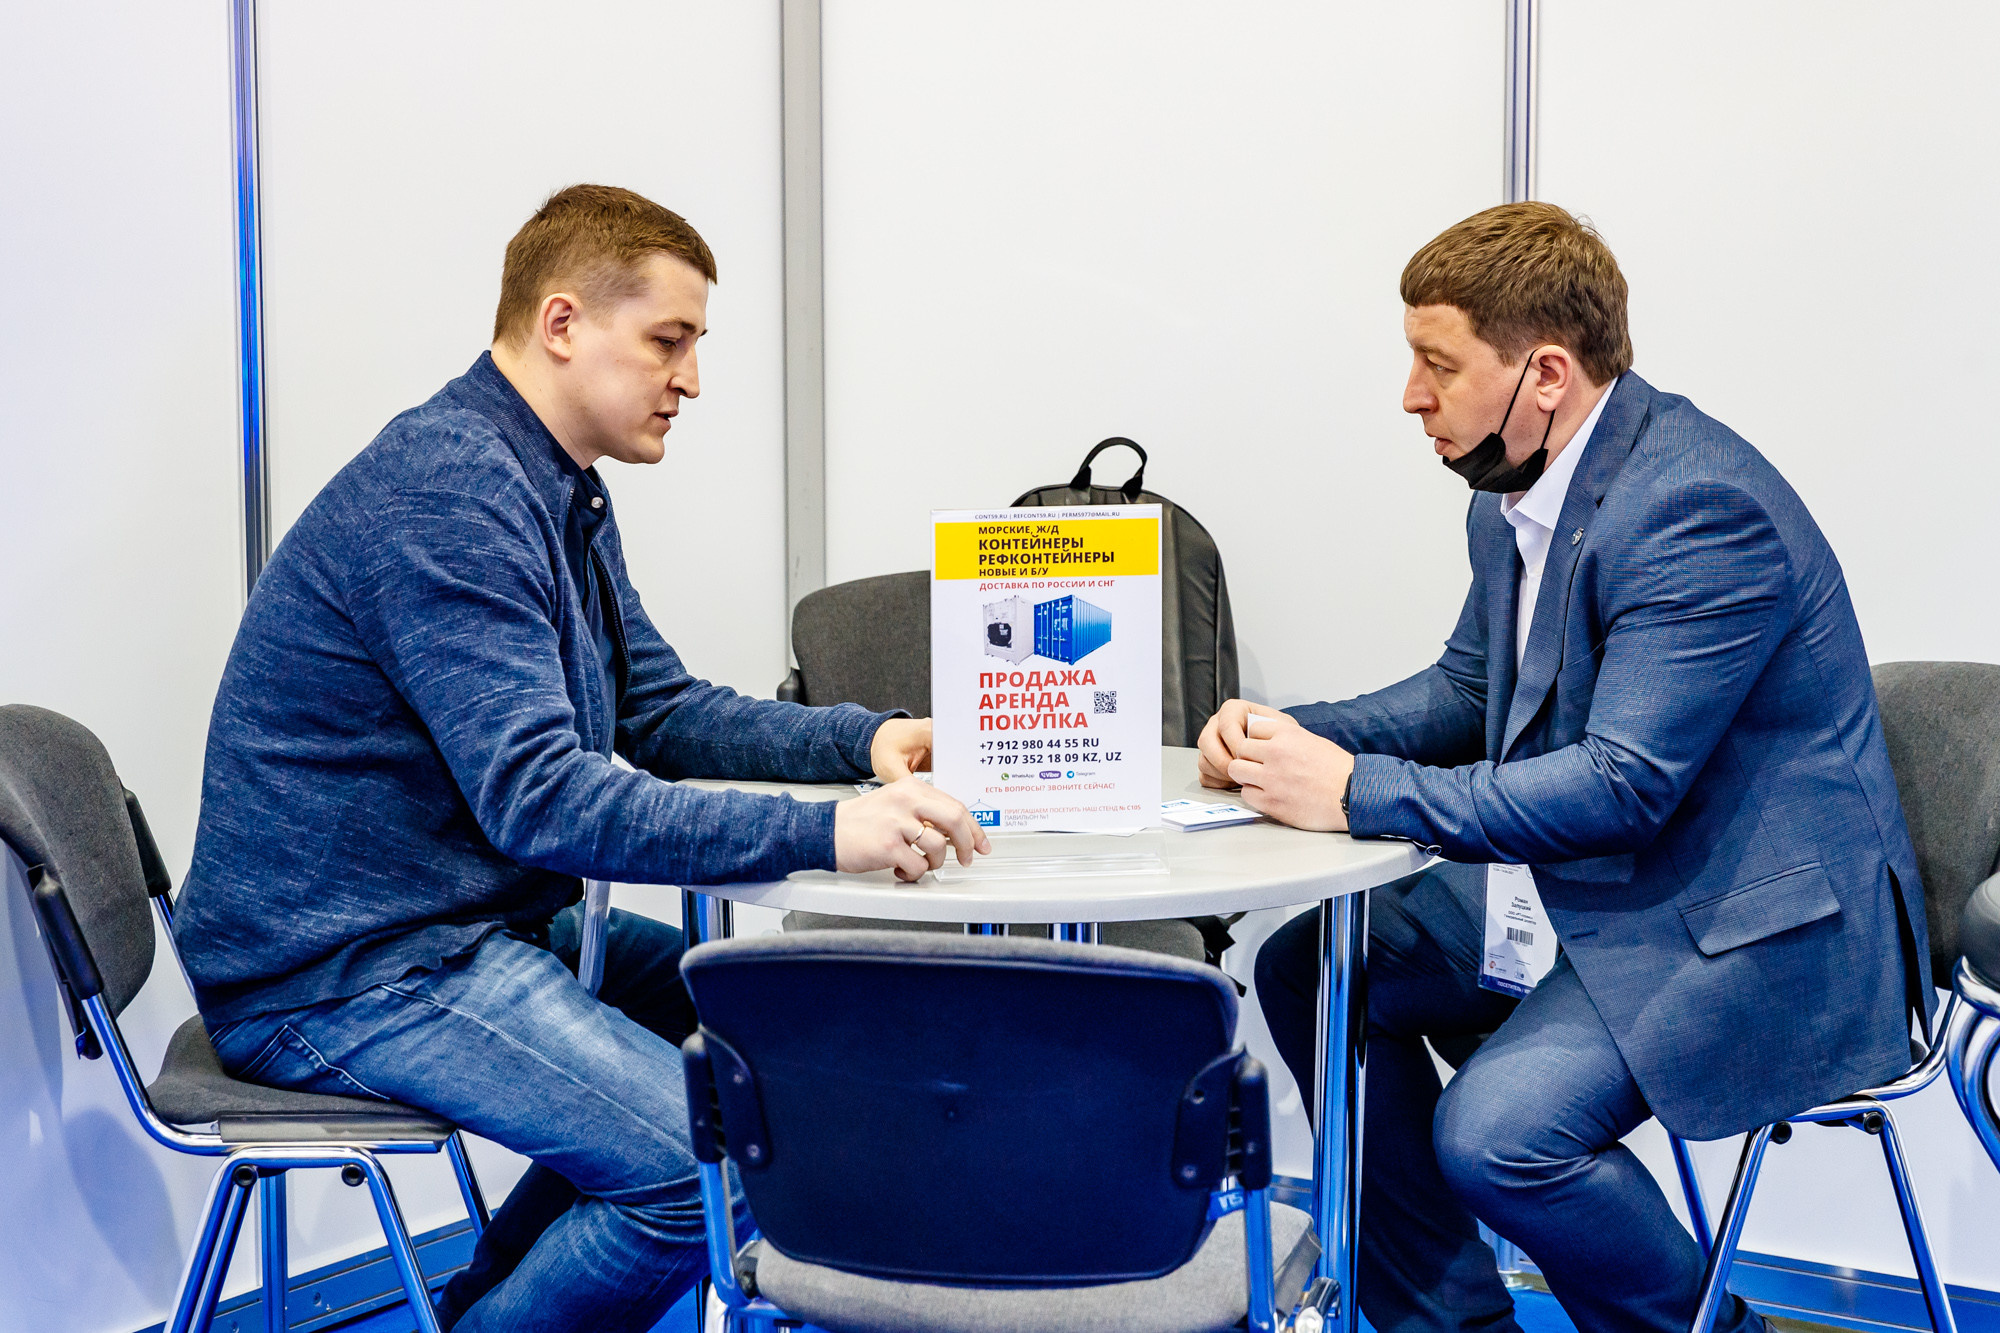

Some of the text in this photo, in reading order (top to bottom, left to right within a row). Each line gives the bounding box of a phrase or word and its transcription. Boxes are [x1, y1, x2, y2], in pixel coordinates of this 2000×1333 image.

[978, 525, 1059, 535] МОРСКИЕ, Ж/Д
[979, 535, 1084, 550] КОНТЕЙНЕРЫ
[979, 549, 1115, 565] РЕФКОНТЕЙНЕРЫ
[979, 567, 1049, 577] НОВЫЕ И Б/У
[979, 581, 1029, 591] ДОСТАВКА
[1032, 581, 1044, 589] ПО
[1047, 580, 1086, 588] РОССИИ
[979, 669, 1097, 691] ПРОДАЖА
[979, 692, 1069, 712] АРЕНДА
[979, 712, 1089, 731] ПОКУПКА
[980, 738, 1099, 751] +7 912 980 44 55 RU
[980, 752, 1122, 765] +7 707 352 18 09 KZ, UZ
[1083, 782, 1115, 790] СЕЙЧАС!
